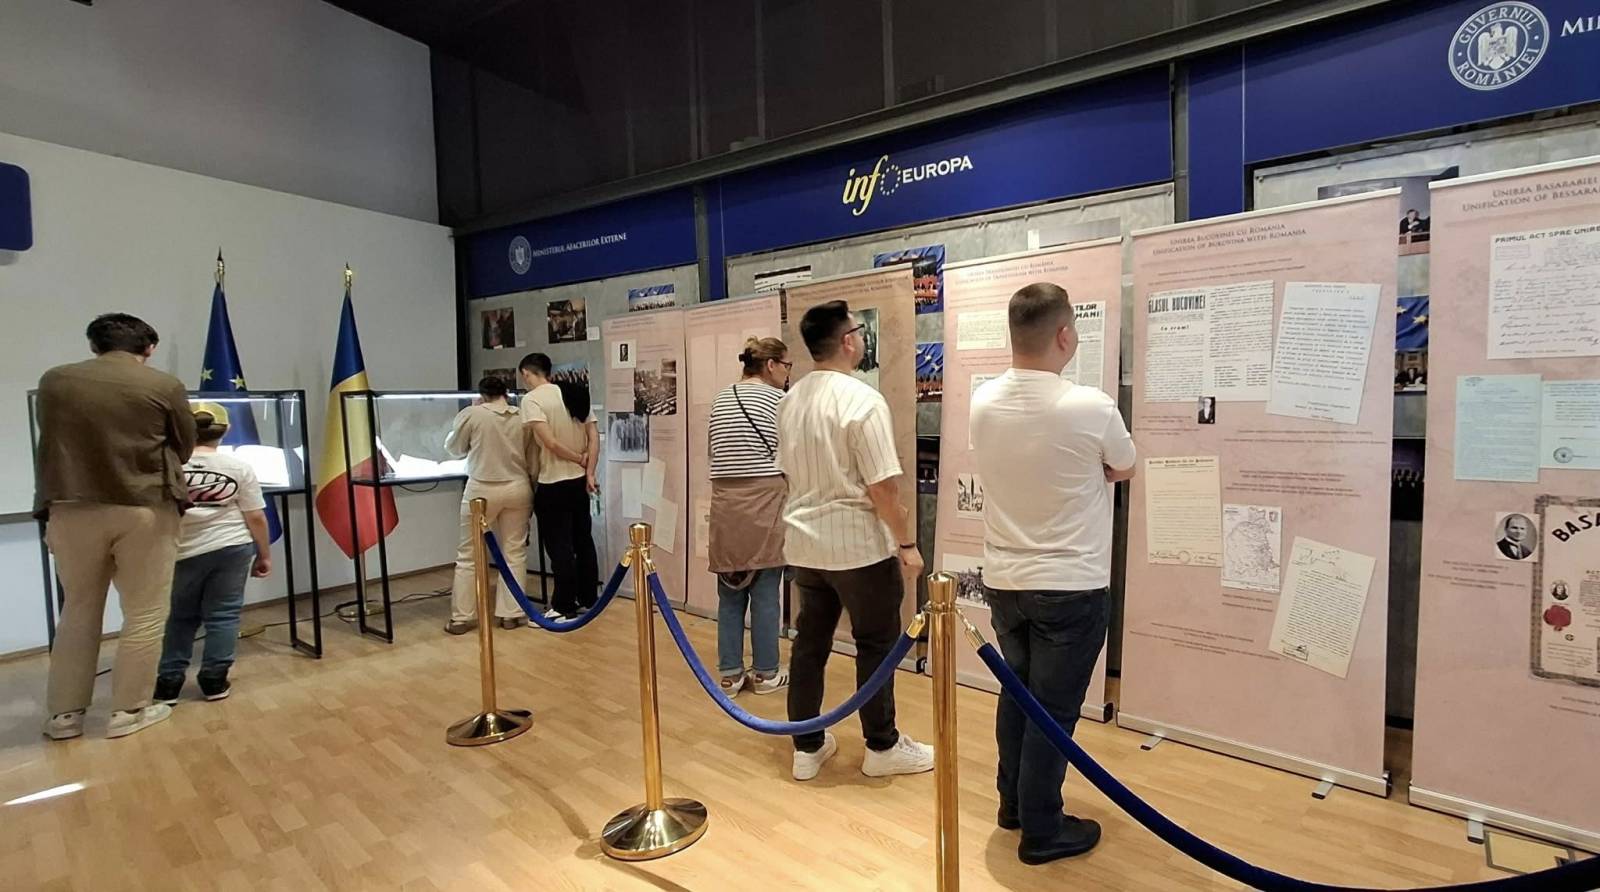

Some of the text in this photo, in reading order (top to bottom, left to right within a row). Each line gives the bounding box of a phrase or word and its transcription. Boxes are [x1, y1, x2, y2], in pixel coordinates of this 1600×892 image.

[1459, 7, 1539, 44] GUVERNUL
[902, 155, 973, 184] EUROPA
[1534, 193, 1547, 203] OF
[1552, 186, 1600, 200] BESSARA
[600, 232, 627, 245] EXTERNE
[1148, 294, 1206, 314] GLASUL BUCOVINEI
